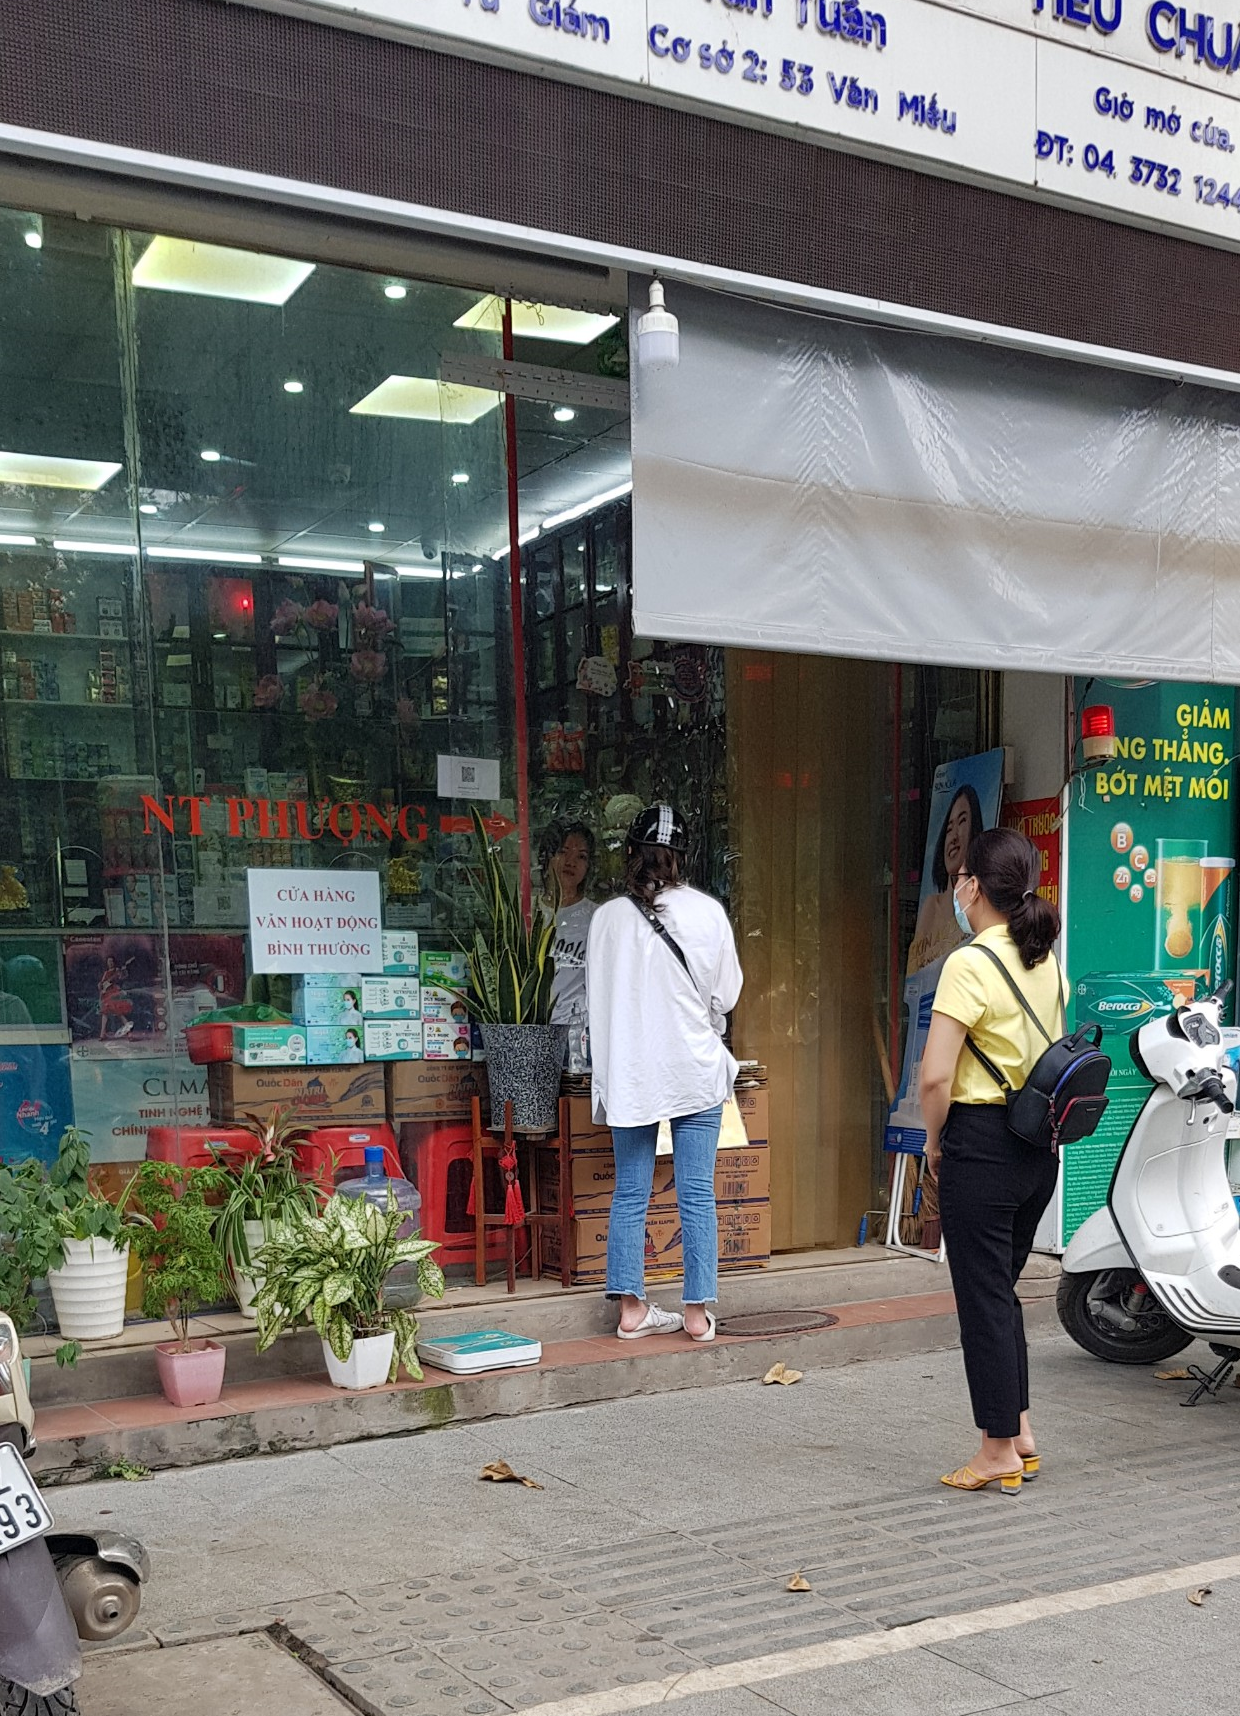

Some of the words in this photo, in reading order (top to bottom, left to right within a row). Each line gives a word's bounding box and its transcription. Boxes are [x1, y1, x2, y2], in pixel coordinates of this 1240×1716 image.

[648, 23, 691, 62] Cơ
[699, 40, 735, 73] sở
[742, 48, 767, 84] 2:
[779, 57, 814, 95] 53
[826, 70, 878, 114] Văn
[897, 89, 957, 135] Miếu
[1144, 105, 1181, 135] mở
[1035, 129, 1074, 166] ĐT:
[1129, 154, 1182, 196] 3732
[1176, 698, 1230, 729] GIẢM
[1096, 765, 1138, 796] BỚT
[1143, 767, 1183, 803] MỆT
[1188, 769, 1229, 800] MỎI
[139, 795, 211, 836] NT
[226, 795, 428, 847] PHƯỢNG
[1117, 833, 1127, 848] B
[1116, 872, 1129, 884] Zn
[1144, 872, 1156, 883] Ca
[277, 886, 309, 902] CỬA
[313, 887, 355, 903] HÀNG
[256, 913, 287, 929] VẪN
[292, 915, 333, 933] HOẠT
[337, 914, 378, 931] ĐỘNG
[267, 942, 303, 956] BÌNH
[307, 940, 371, 956] THƯỜNG
[1098, 1001, 1142, 1011] Berocca
[138, 1108, 166, 1119] TINH
